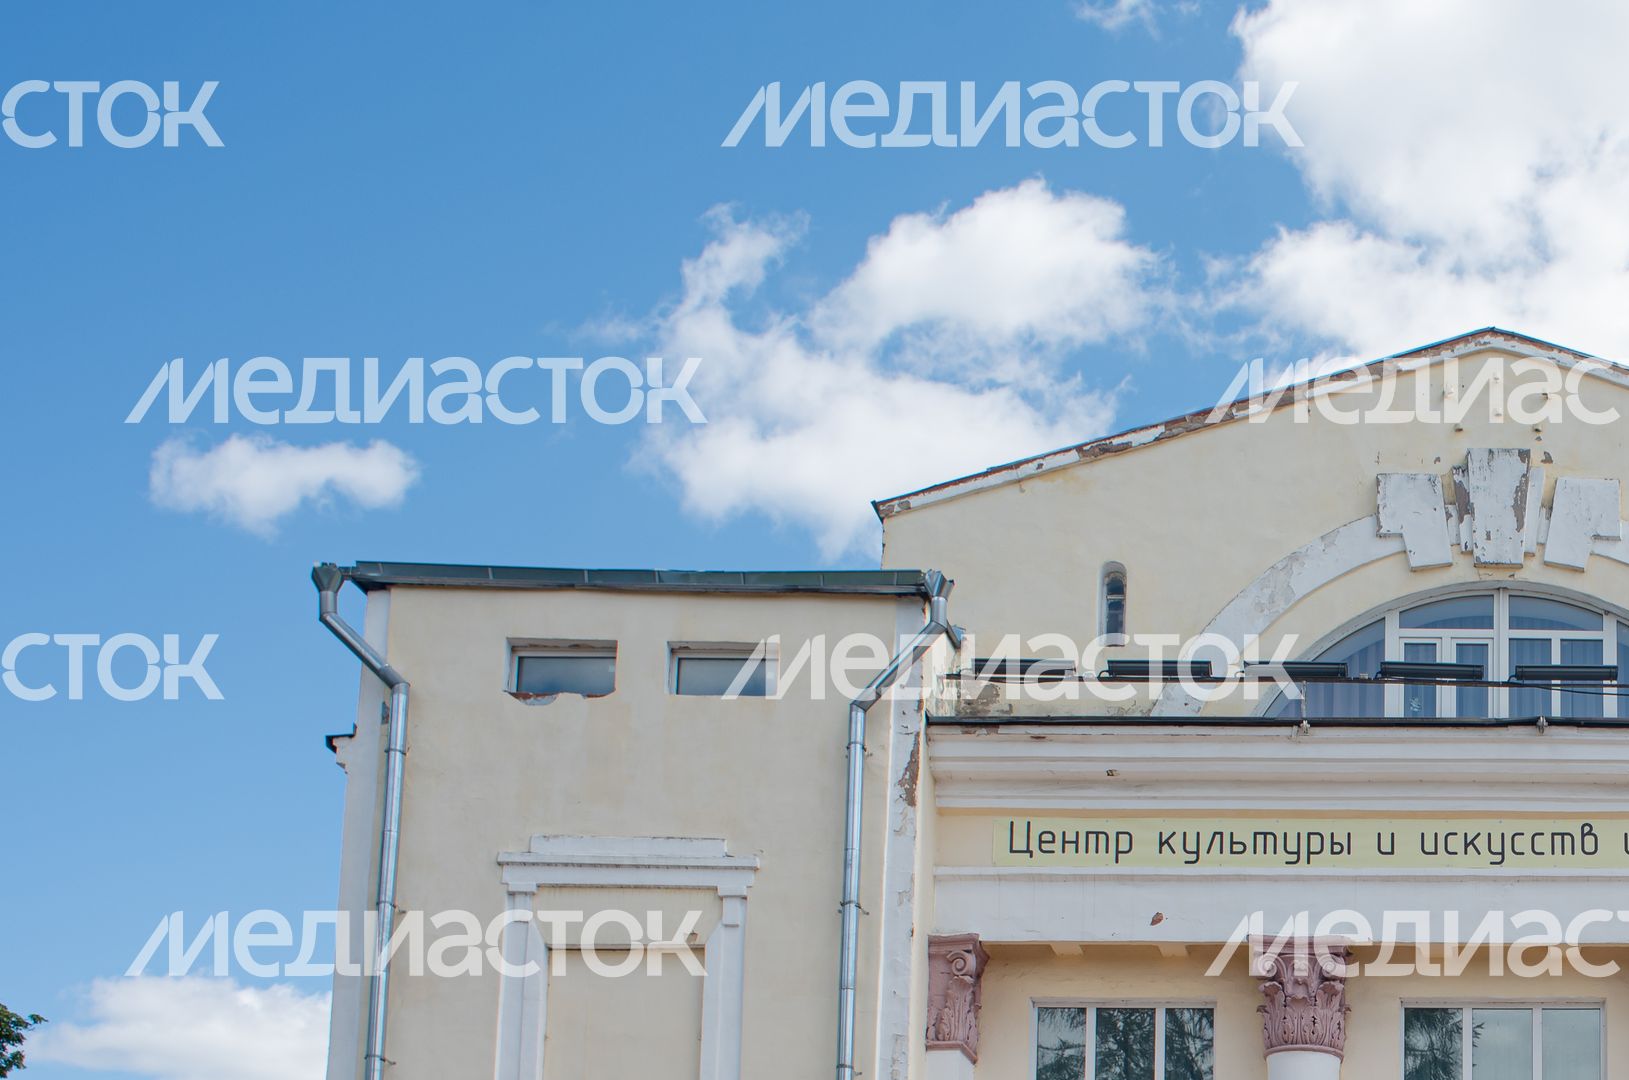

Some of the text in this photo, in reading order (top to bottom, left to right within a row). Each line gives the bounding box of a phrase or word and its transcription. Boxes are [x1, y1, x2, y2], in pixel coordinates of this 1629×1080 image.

[1008, 820, 1134, 865] Центр
[1158, 830, 1352, 867] культуры
[1377, 832, 1396, 856] и
[1420, 822, 1599, 867] искусств
